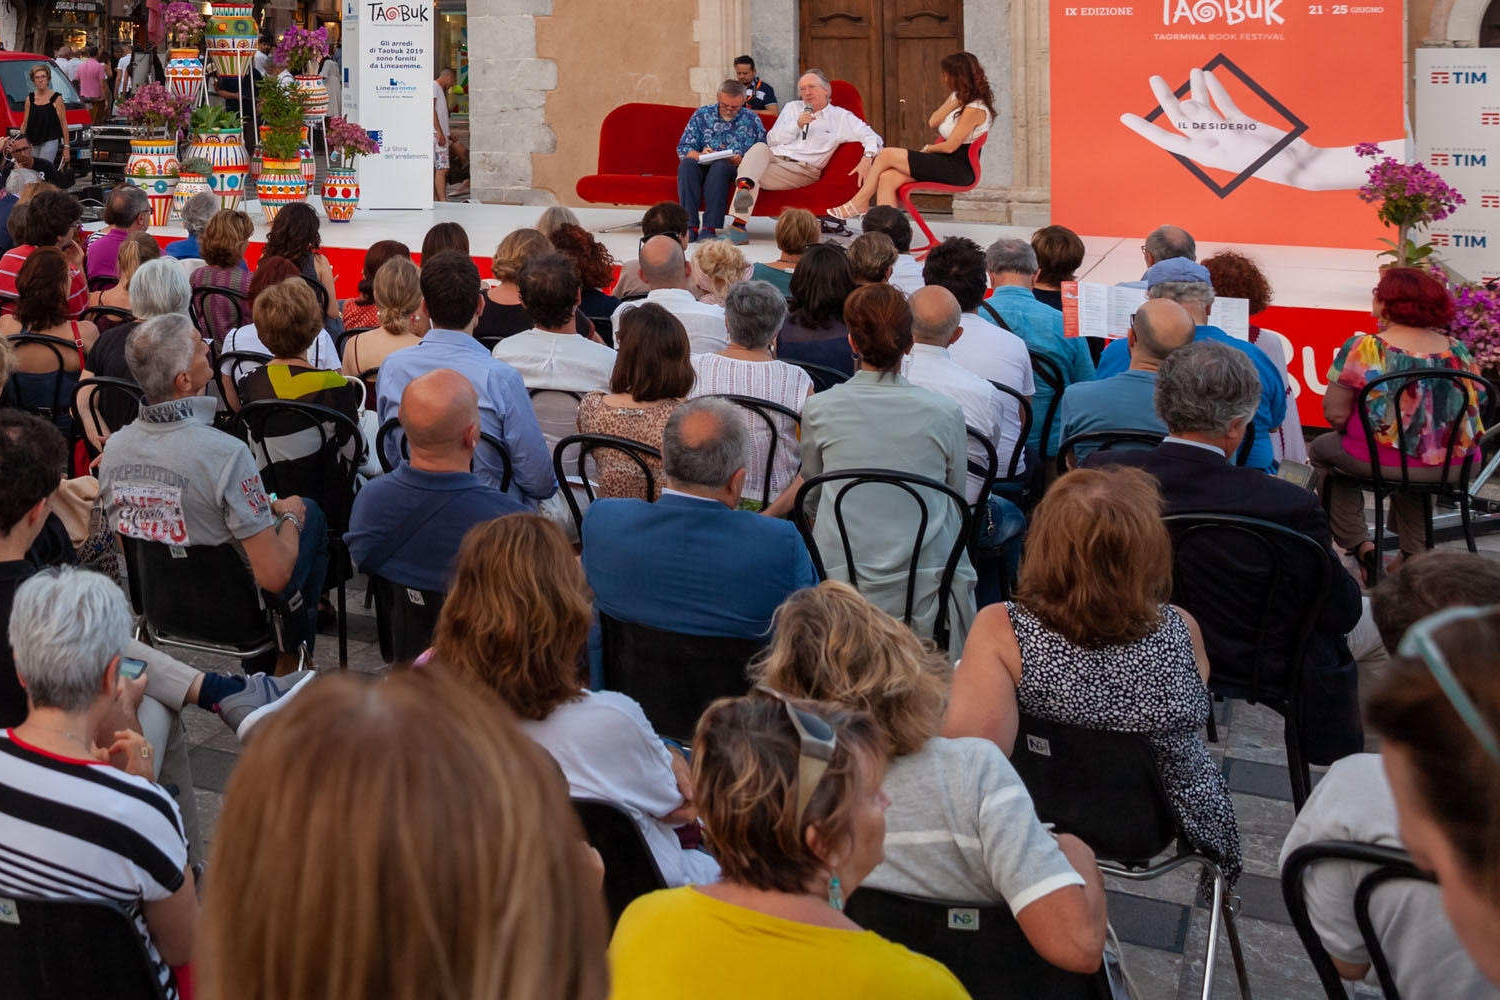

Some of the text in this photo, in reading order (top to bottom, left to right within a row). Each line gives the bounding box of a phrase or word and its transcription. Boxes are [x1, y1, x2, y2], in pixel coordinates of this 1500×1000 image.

[1065, 7, 1134, 16] IX EDIZIONE
[1308, 5, 1324, 15] 21
[1332, 5, 1348, 15] 25
[1350, 6, 1384, 14] GIUGNO
[1153, 33, 1285, 41] TAORMINA BOOK FESTIVAL
[1452, 72, 1487, 84] TIM
[1192, 122, 1257, 131] DESIDERIO
[1452, 154, 1487, 167] TIM
[1452, 235, 1487, 248] TIM
